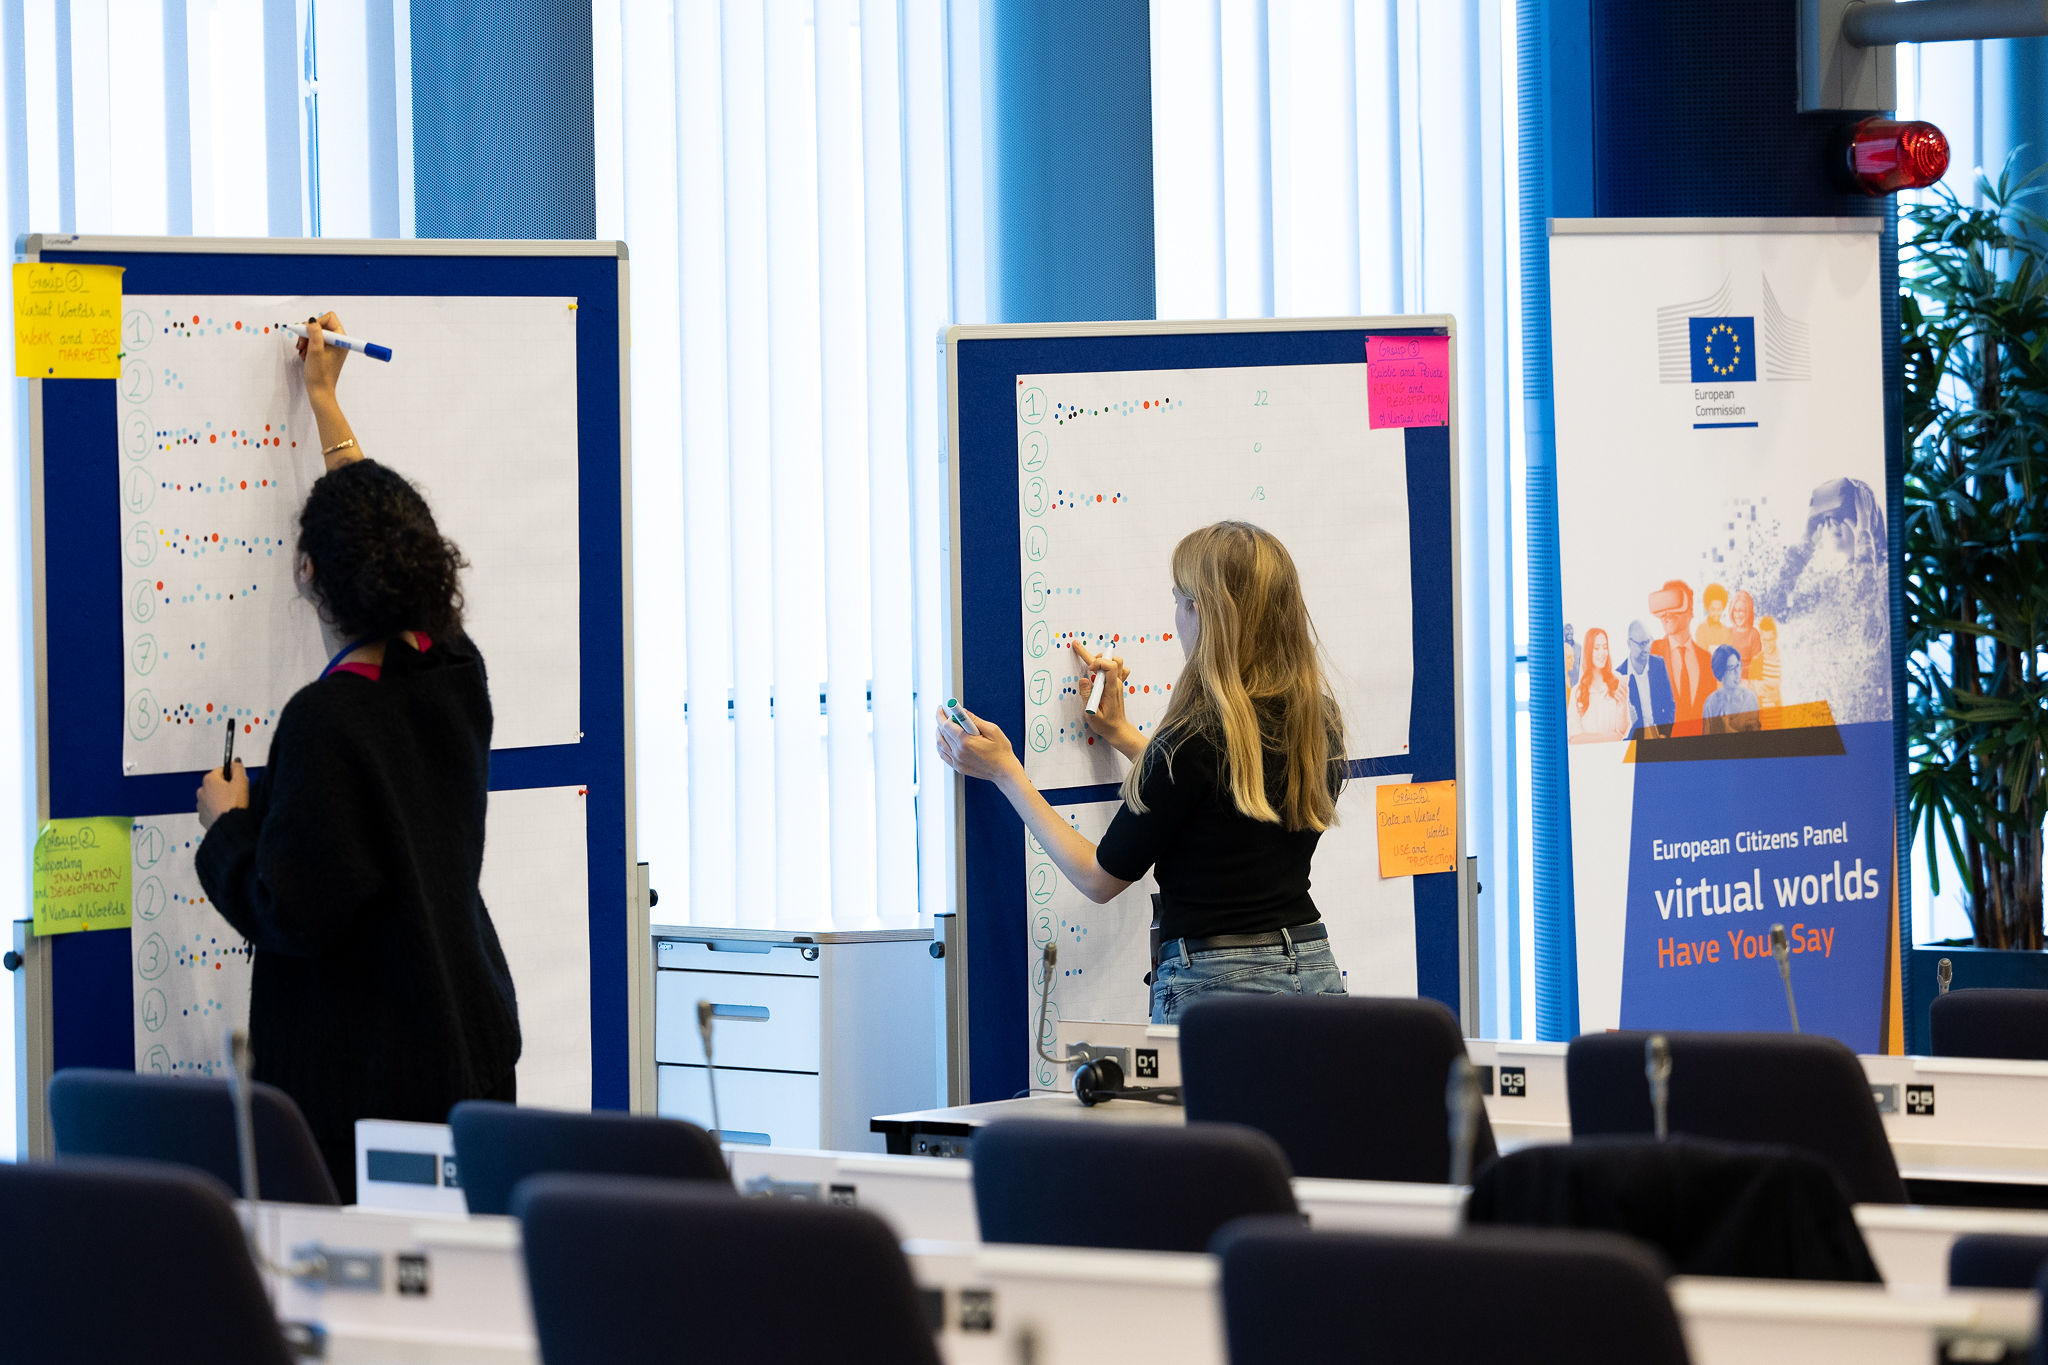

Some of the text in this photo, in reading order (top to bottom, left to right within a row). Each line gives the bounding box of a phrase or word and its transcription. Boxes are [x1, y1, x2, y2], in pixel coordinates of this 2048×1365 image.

[18, 296, 52, 317] Virtual
[58, 301, 95, 318] Worlds
[59, 330, 83, 345] and
[58, 347, 112, 364] MARKETS
[1368, 362, 1443, 378] Public and Private
[1409, 384, 1424, 394] and
[1694, 389, 1735, 402] European
[1254, 390, 1269, 407] 22
[1388, 409, 1414, 424] Virtual
[1695, 404, 1746, 417] Commission
[1379, 807, 1441, 827] Data in Virtual
[1393, 842, 1428, 857] USE and
[1653, 821, 1848, 863] European Citizens Panel
[54, 866, 122, 884] INNOVATION
[48, 882, 119, 898] DEVELOPMENT
[1655, 858, 1880, 920] virtual worlds
[49, 902, 83, 920] Virtual
[86, 900, 126, 918] Worlds
[1657, 923, 1835, 969] Have You Say
[1137, 1055, 1157, 1067] 01
[1501, 1073, 1525, 1087] 03
[1907, 1090, 1934, 1105] 05
[1915, 1105, 1926, 1113] M
